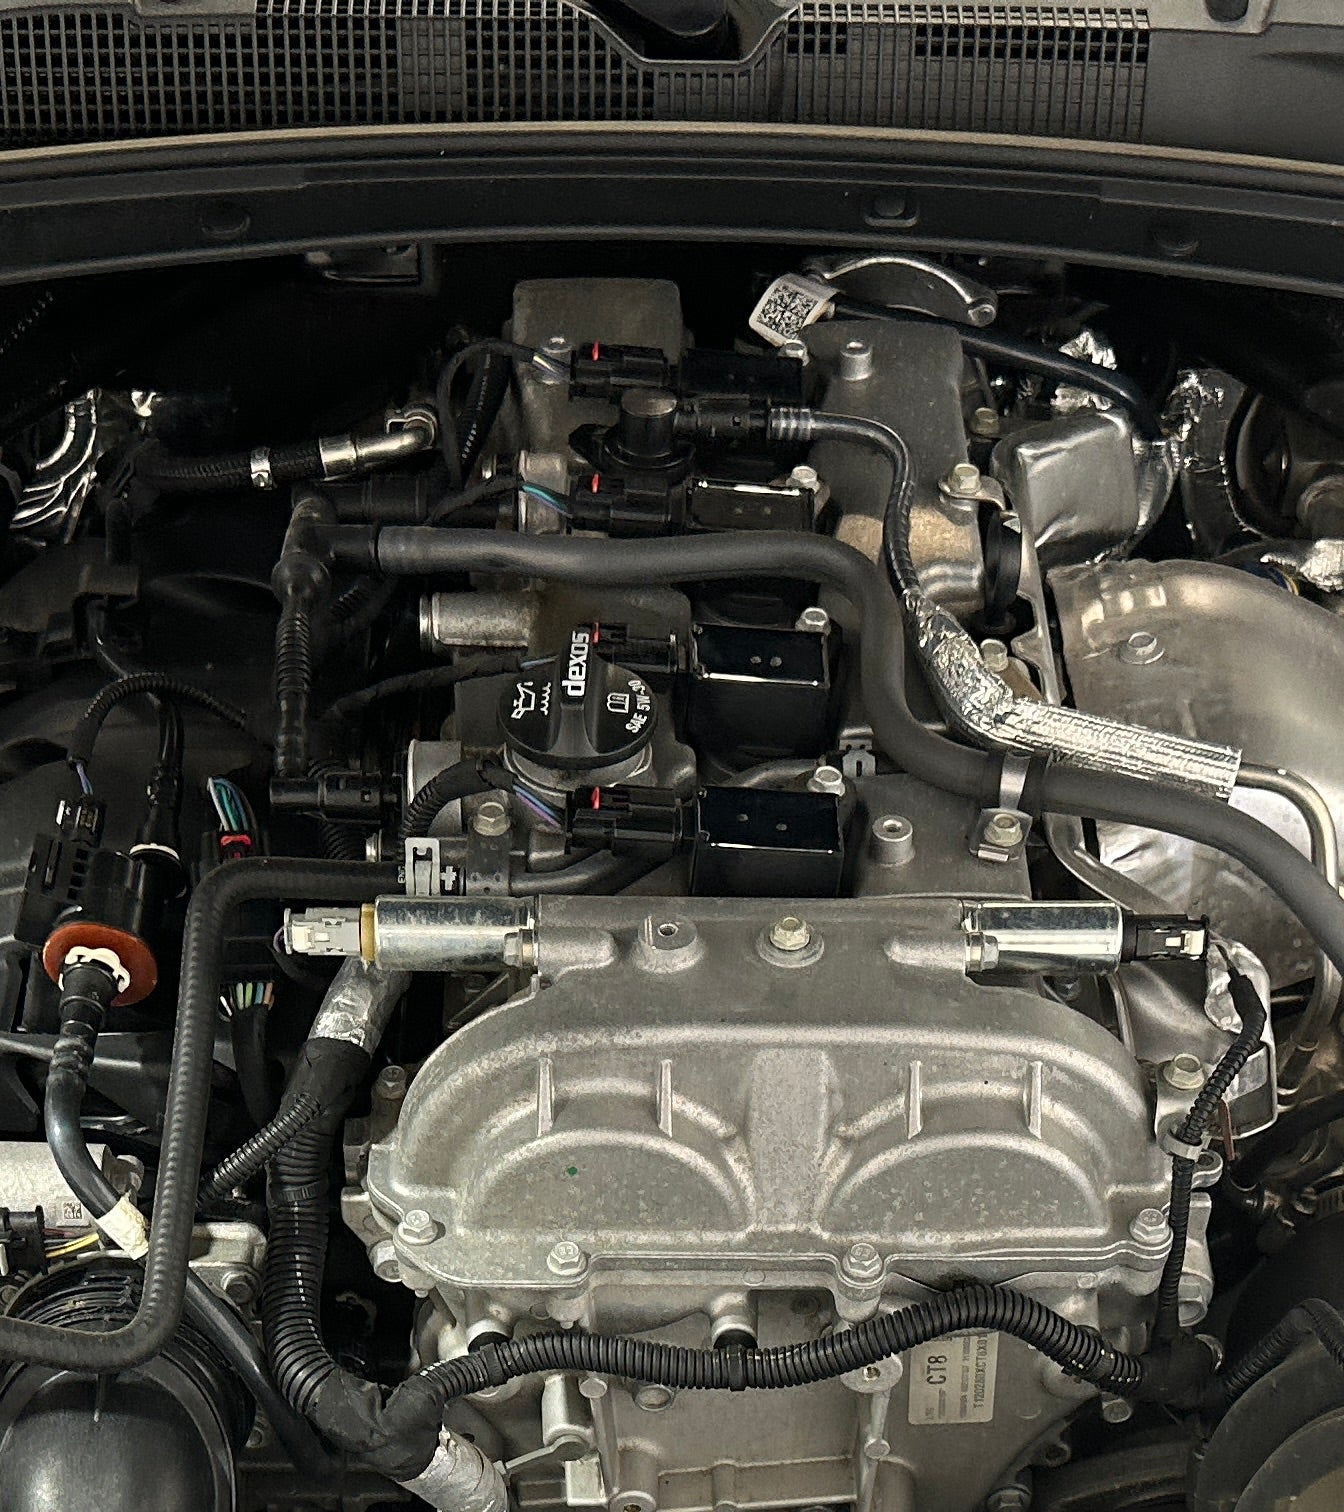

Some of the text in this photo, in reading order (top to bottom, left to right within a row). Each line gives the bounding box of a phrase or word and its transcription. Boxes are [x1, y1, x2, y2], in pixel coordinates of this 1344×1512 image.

[562, 631, 589, 696] dexos
[625, 680, 651, 734] SAE 5W-30
[927, 1354, 947, 1385] CT8
